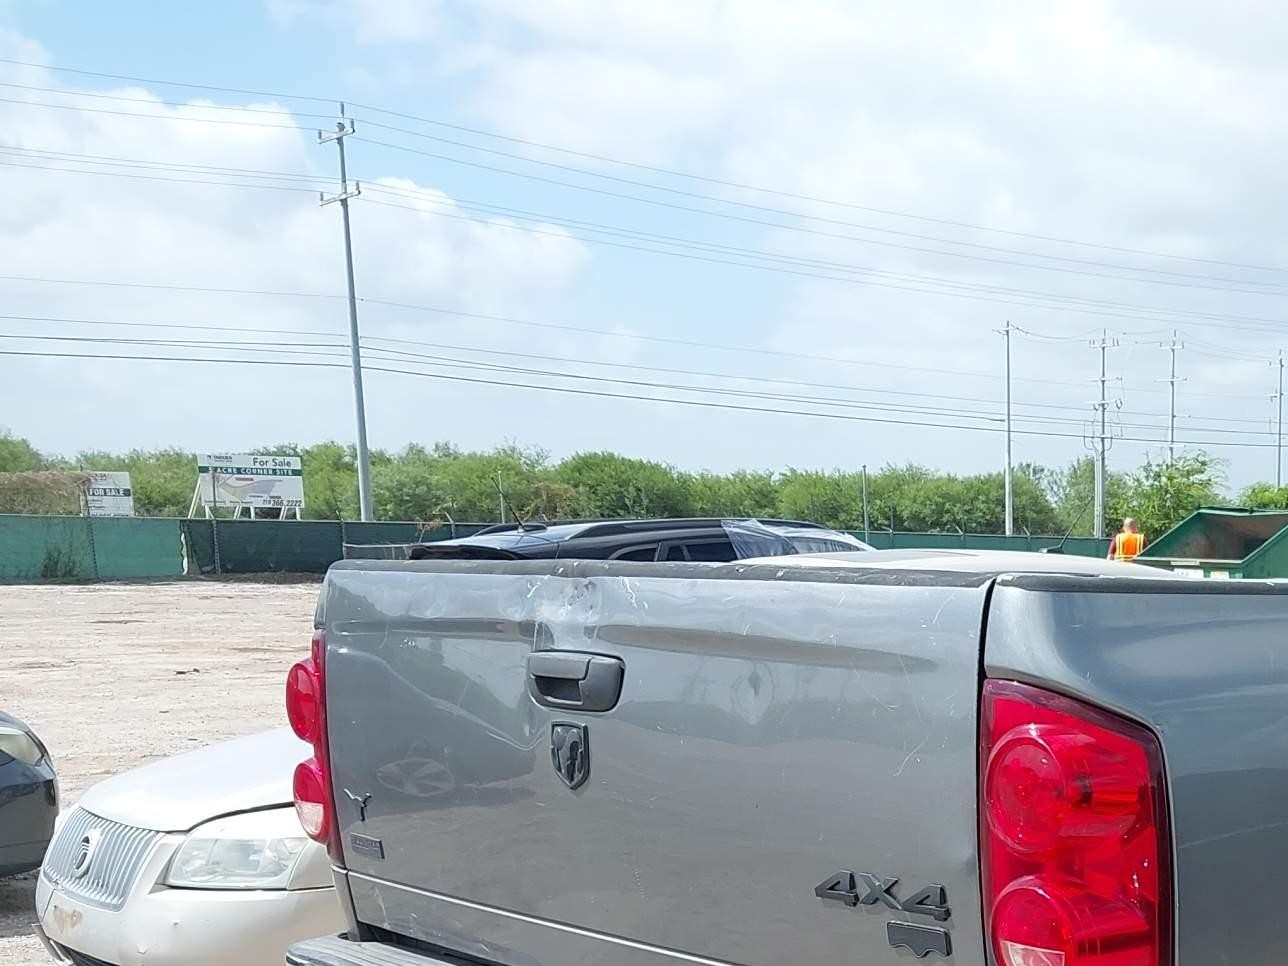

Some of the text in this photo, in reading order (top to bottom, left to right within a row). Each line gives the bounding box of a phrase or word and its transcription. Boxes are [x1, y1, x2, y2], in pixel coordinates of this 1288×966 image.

[253, 457, 292, 468] For Sale
[89, 488, 125, 497] FOR SALE
